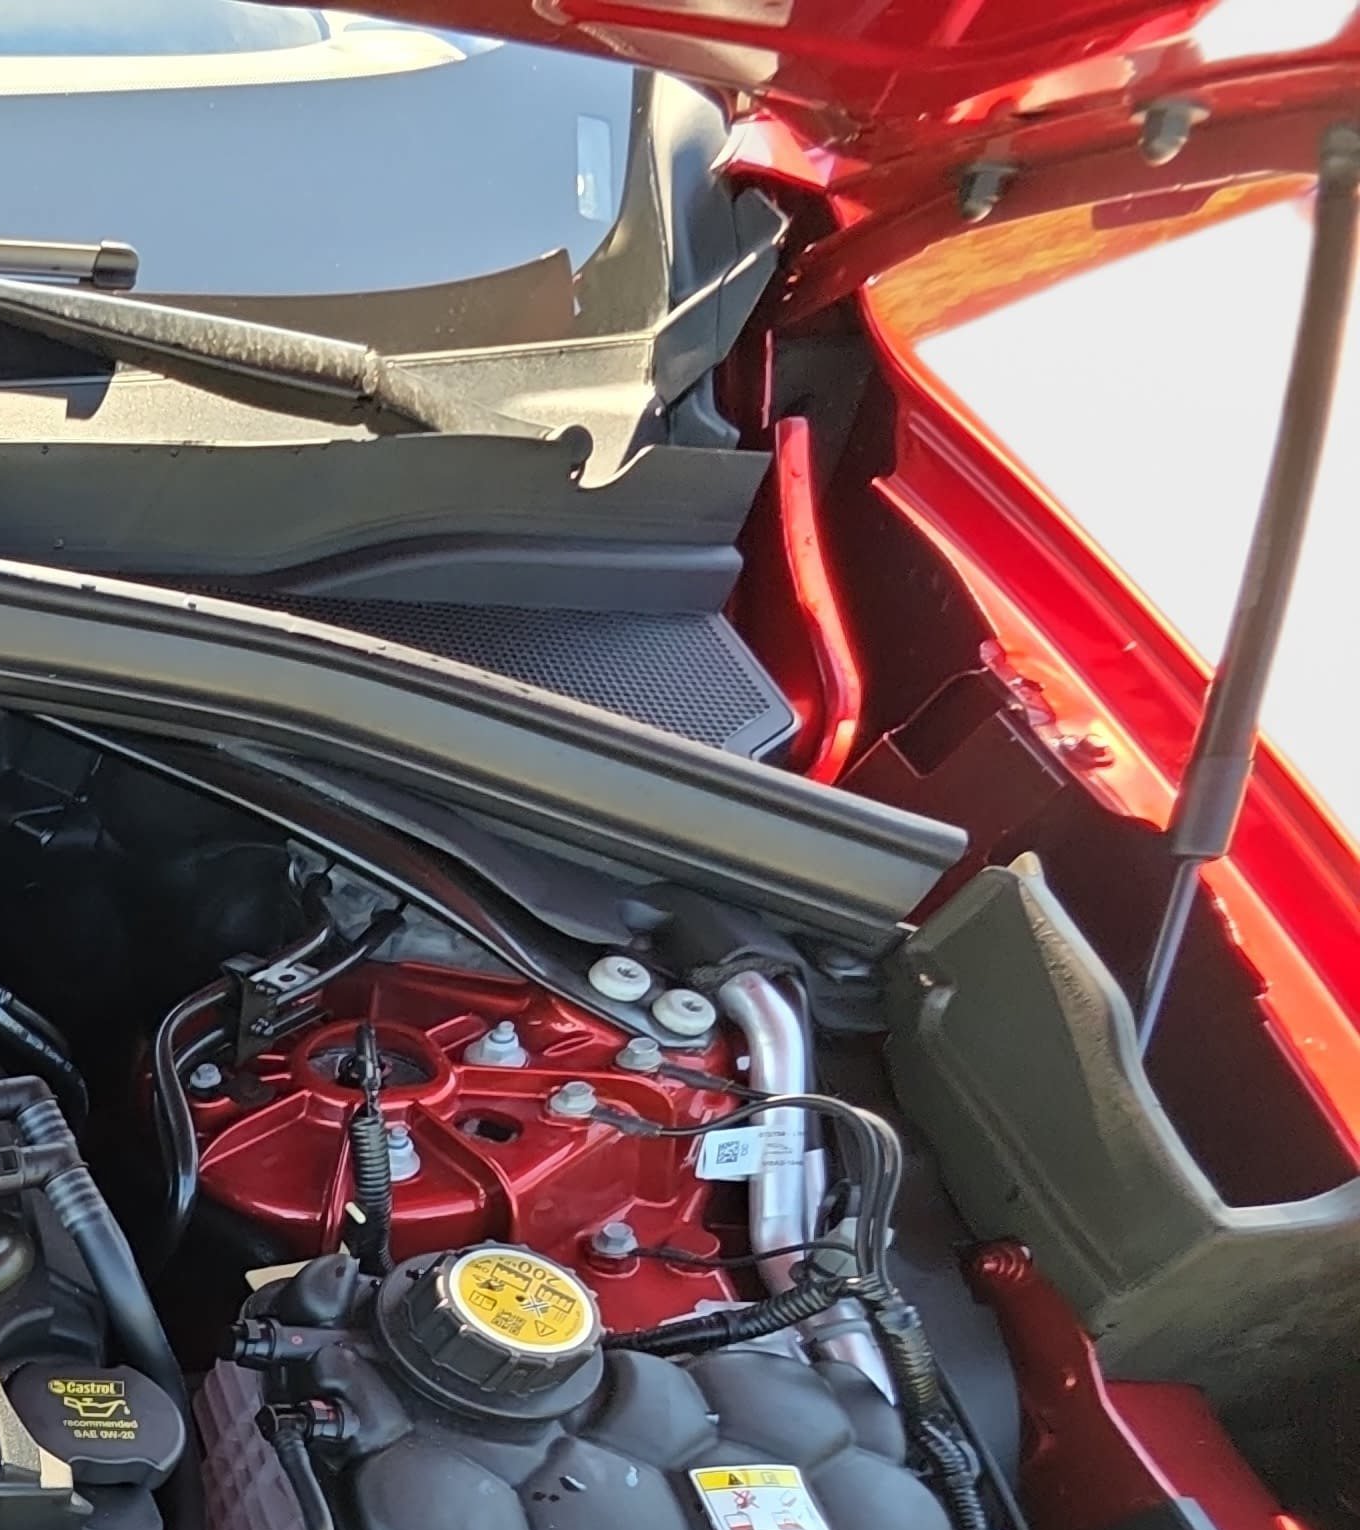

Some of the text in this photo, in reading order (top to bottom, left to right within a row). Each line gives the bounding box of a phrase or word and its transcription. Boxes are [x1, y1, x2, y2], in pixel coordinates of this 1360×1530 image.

[517, 1260, 562, 1287] 200
[66, 1381, 116, 1394] Castrol
[63, 1419, 138, 1429] recommended
[74, 1430, 98, 1439] SAE
